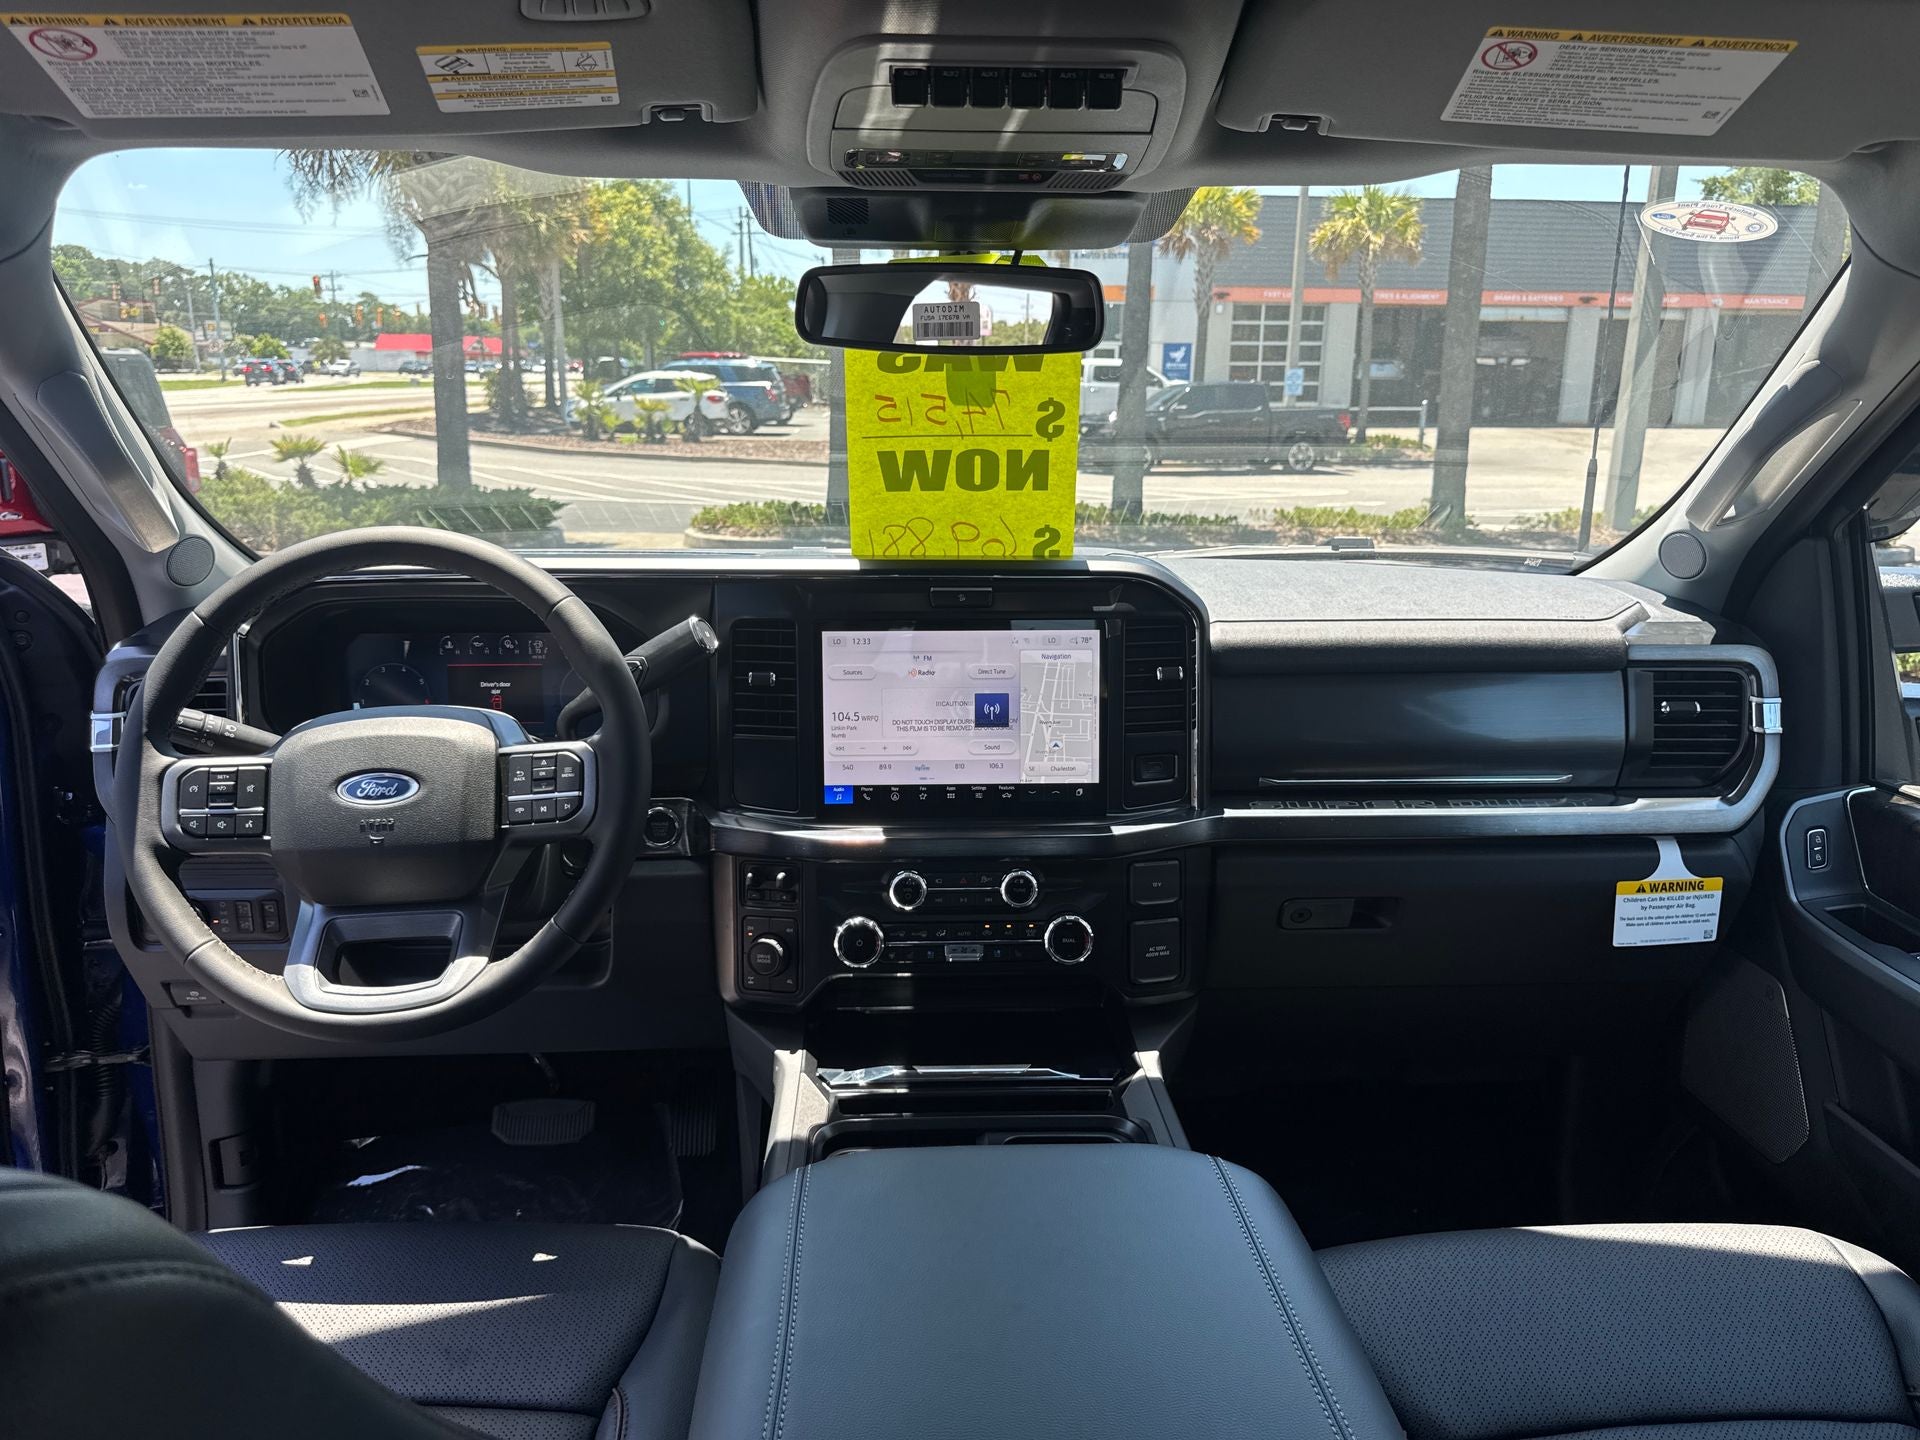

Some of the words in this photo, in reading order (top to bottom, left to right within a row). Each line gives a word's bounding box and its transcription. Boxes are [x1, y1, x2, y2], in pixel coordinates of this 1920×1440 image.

[25, 16, 90, 26] WARNING
[124, 16, 228, 26] AVERTISSEMENT
[260, 16, 347, 25] ADVERTENCIA
[1506, 29, 1560, 41] WARNING
[1589, 33, 1683, 47] AVERTISSEMENT
[1708, 39, 1791, 52] ADVERTENCIA
[923, 305, 965, 314] AUTODIM
[1041, 653, 1071, 661] Navigation
[831, 711, 860, 722] 104.5
[356, 779, 399, 797] Ford
[1649, 881, 1705, 893] WARNING
[1692, 893, 1715, 901] INJURED
[1640, 904, 1647, 912] by
[1648, 903, 1675, 911] Passenger
